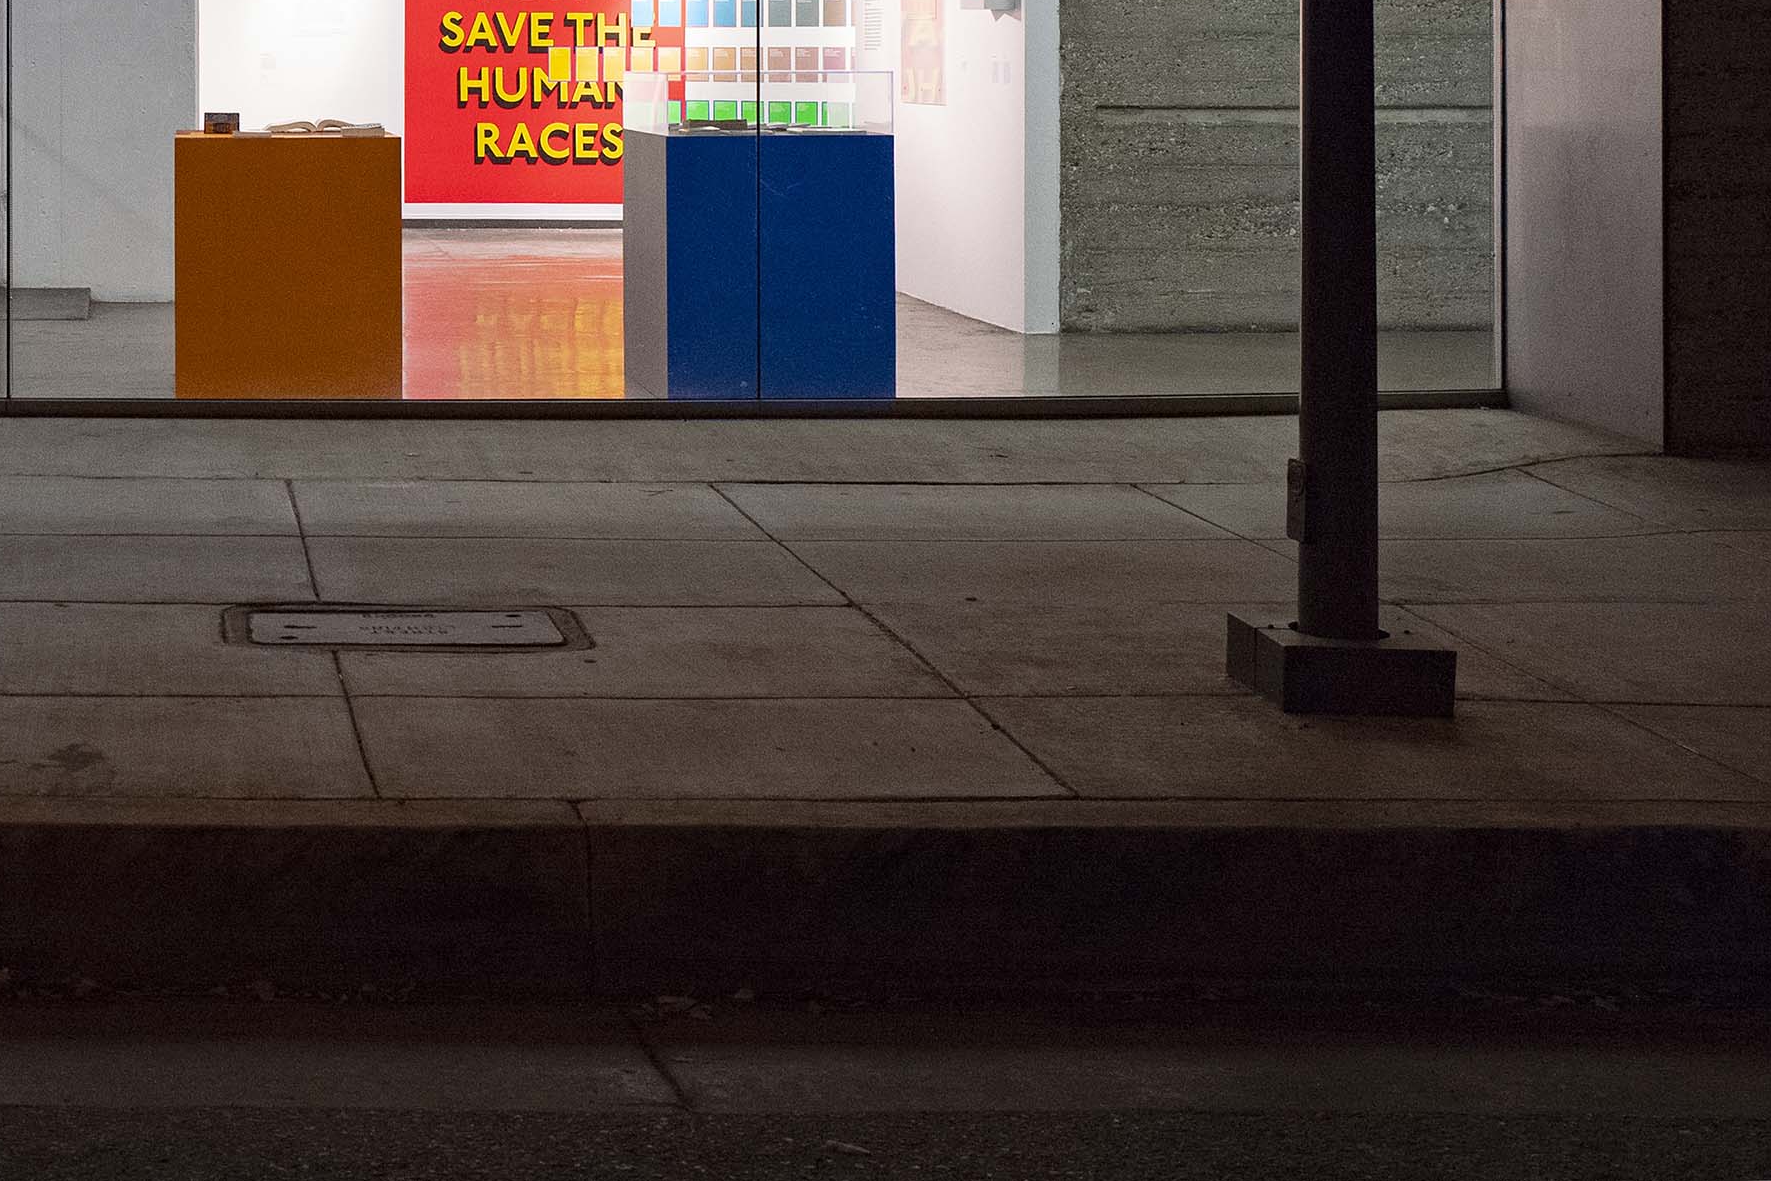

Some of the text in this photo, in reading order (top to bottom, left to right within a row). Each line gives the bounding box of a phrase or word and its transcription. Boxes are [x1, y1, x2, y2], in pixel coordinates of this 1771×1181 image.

[439, 11, 656, 53] SAVE THE
[474, 122, 624, 166] RACES
